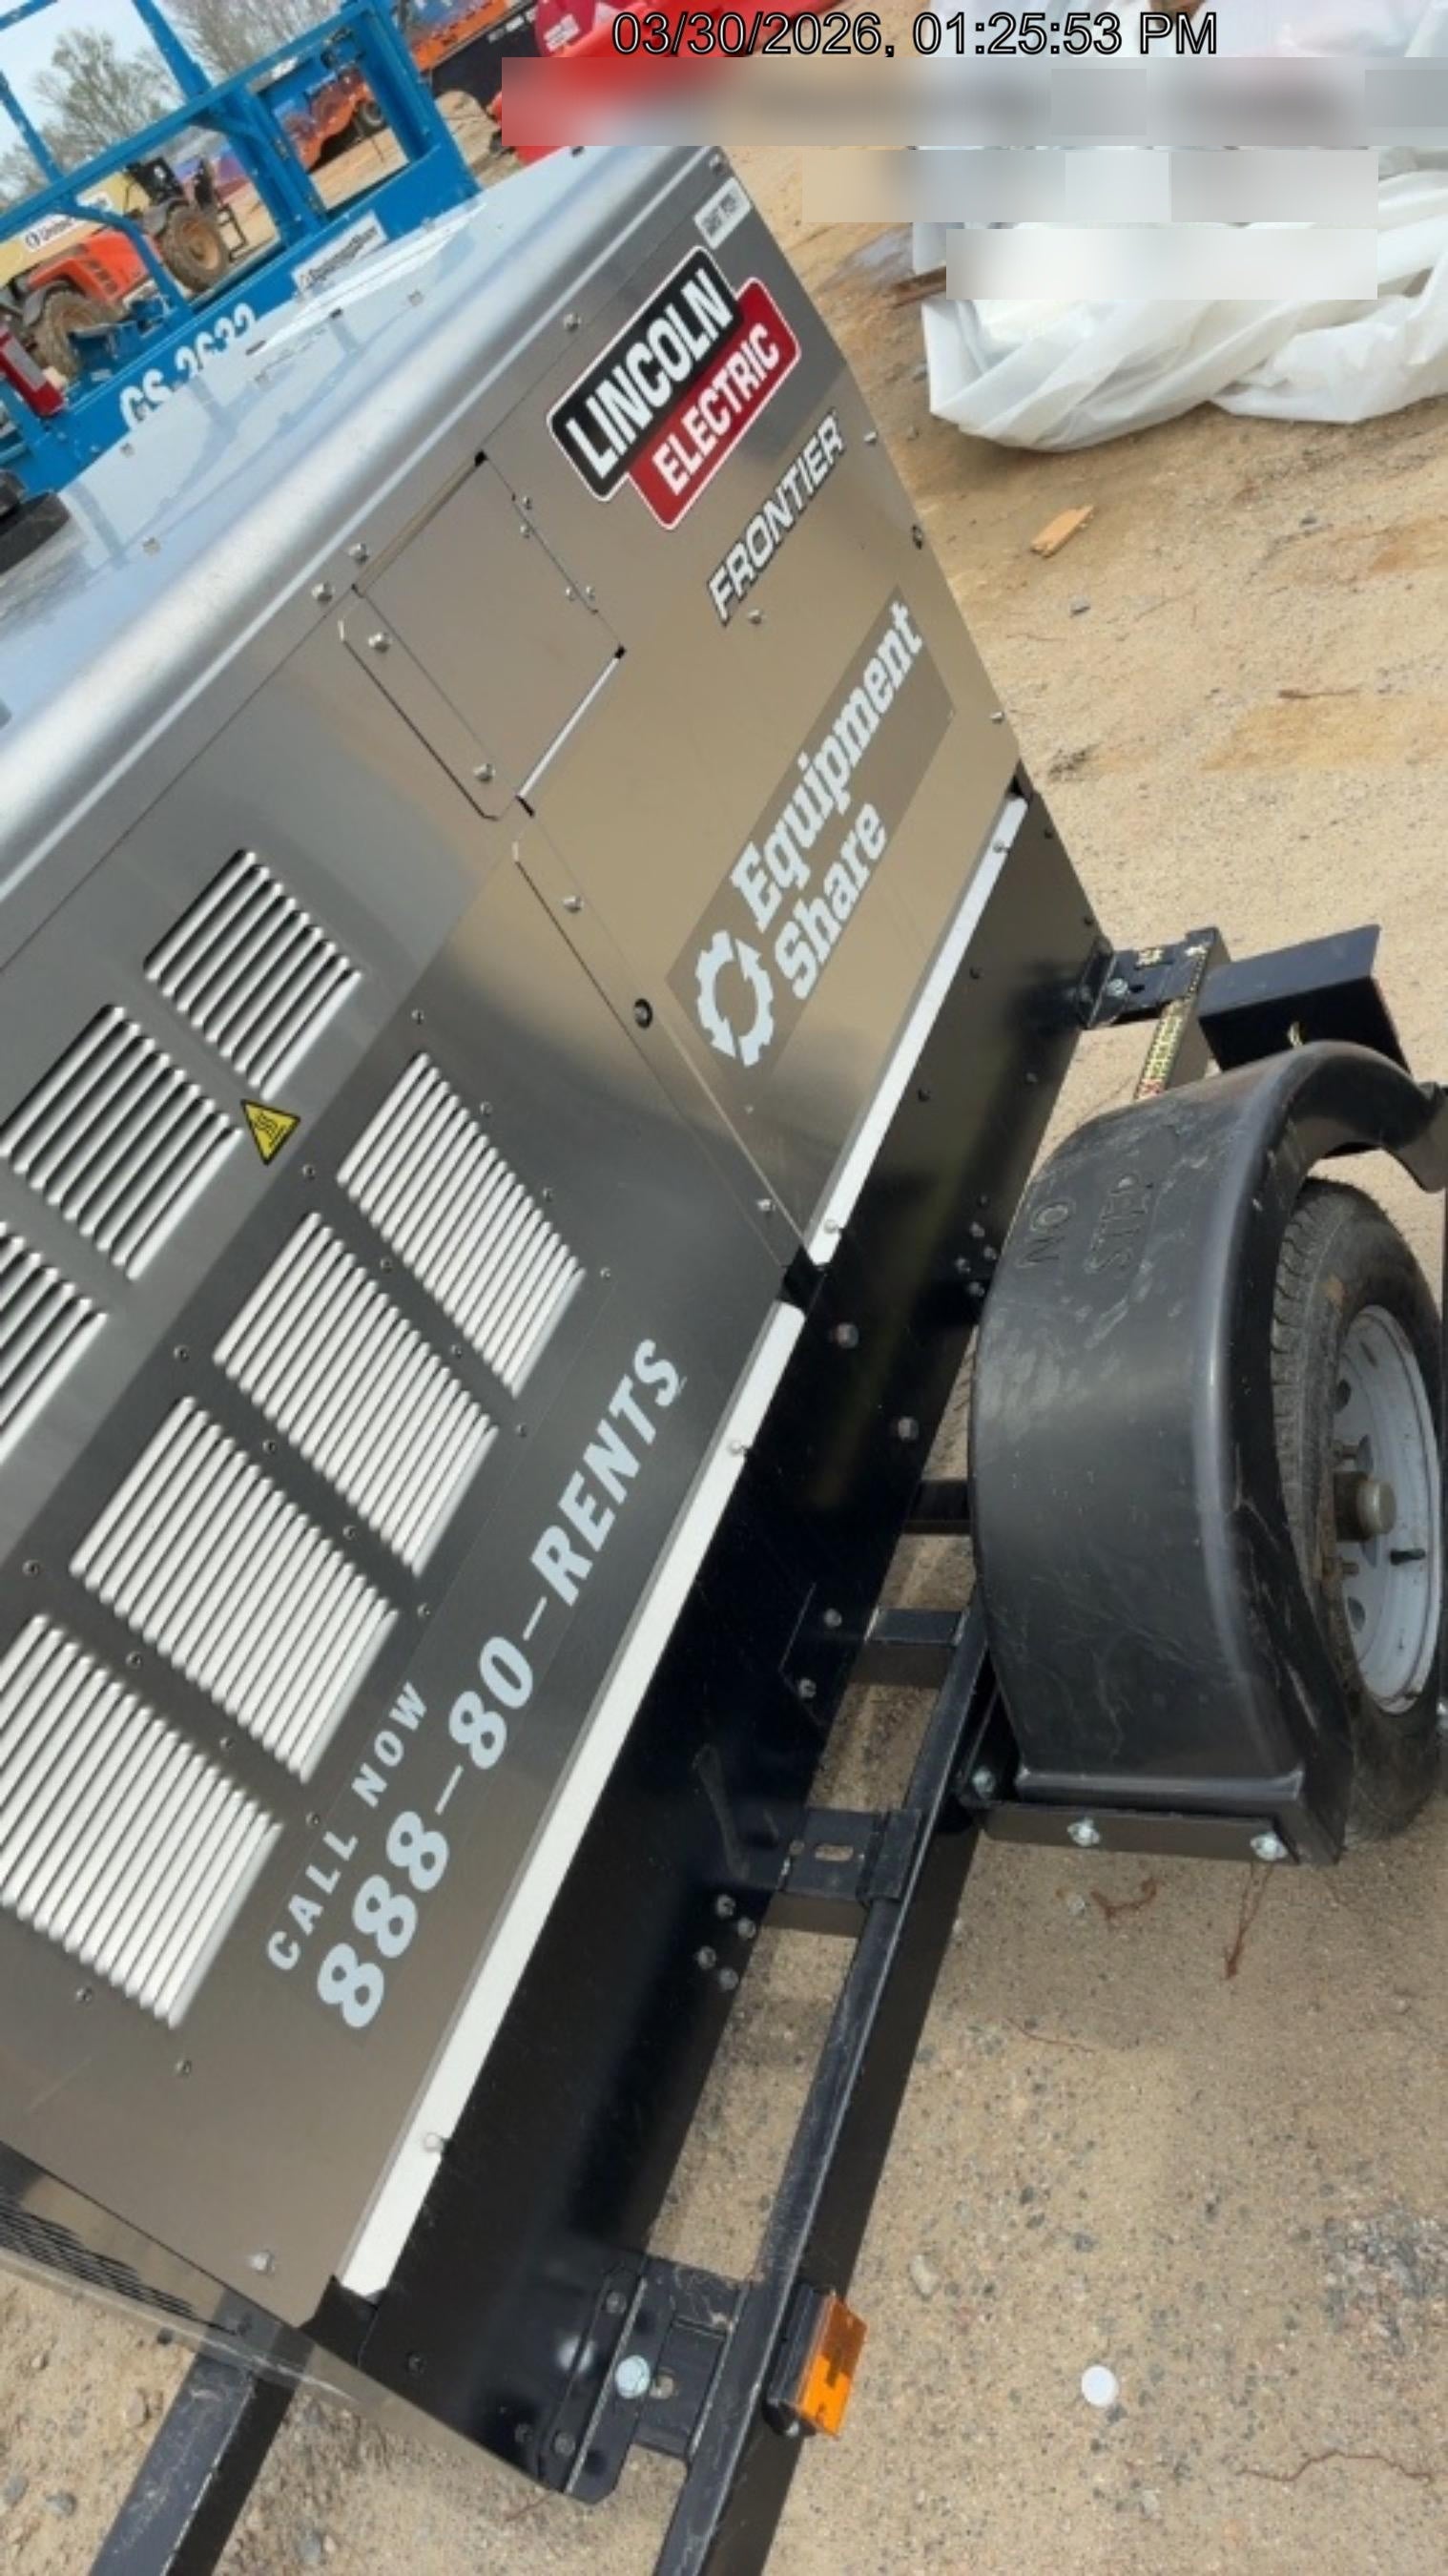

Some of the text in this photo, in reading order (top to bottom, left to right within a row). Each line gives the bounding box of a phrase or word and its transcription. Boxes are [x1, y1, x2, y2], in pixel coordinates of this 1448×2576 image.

[567, 268, 734, 478] LINCOLN
[652, 322, 780, 495] ELECTRIC
[708, 412, 844, 625] FRONTIER
[730, 602, 923, 932] Equipment
[775, 804, 887, 1000] Share
[1015, 1196, 1077, 1269] NO
[1084, 1174, 1152, 1274] STEP
[317, 1339, 679, 2028] 888-80-RENTS
[267, 1682, 427, 1970] CALL NOW
